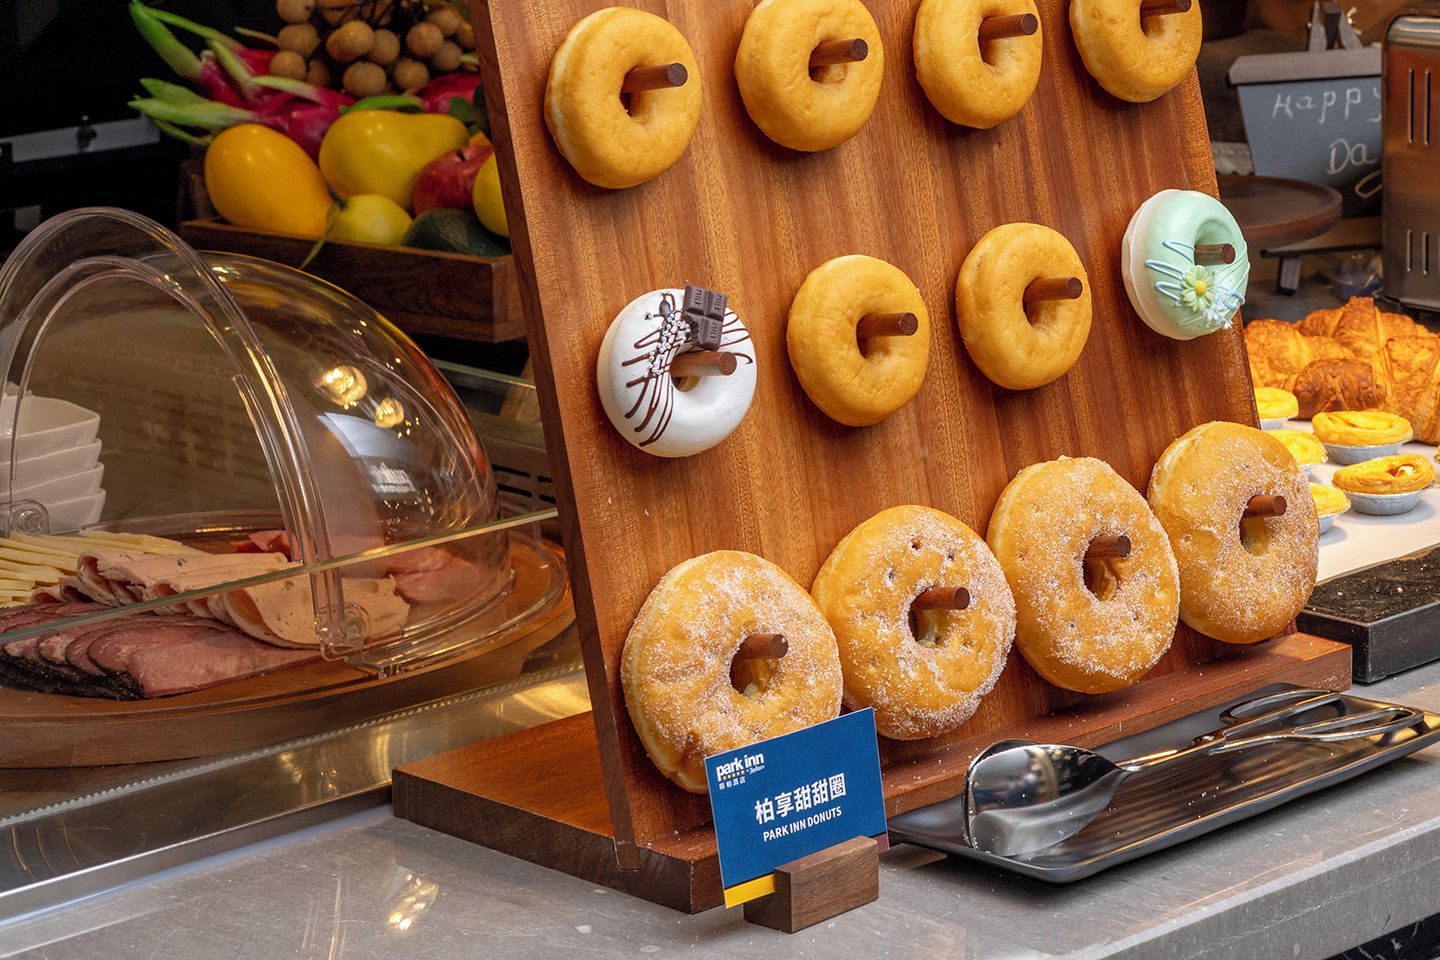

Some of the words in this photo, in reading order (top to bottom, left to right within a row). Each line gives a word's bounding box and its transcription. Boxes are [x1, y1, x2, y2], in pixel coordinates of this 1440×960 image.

[716, 757, 743, 781] park
[744, 753, 764, 767] inn
[754, 773, 847, 824] 柏享甜甜圈
[763, 825, 789, 842] PARK
[790, 818, 807, 834] INN
[808, 806, 842, 827] DONUTS
